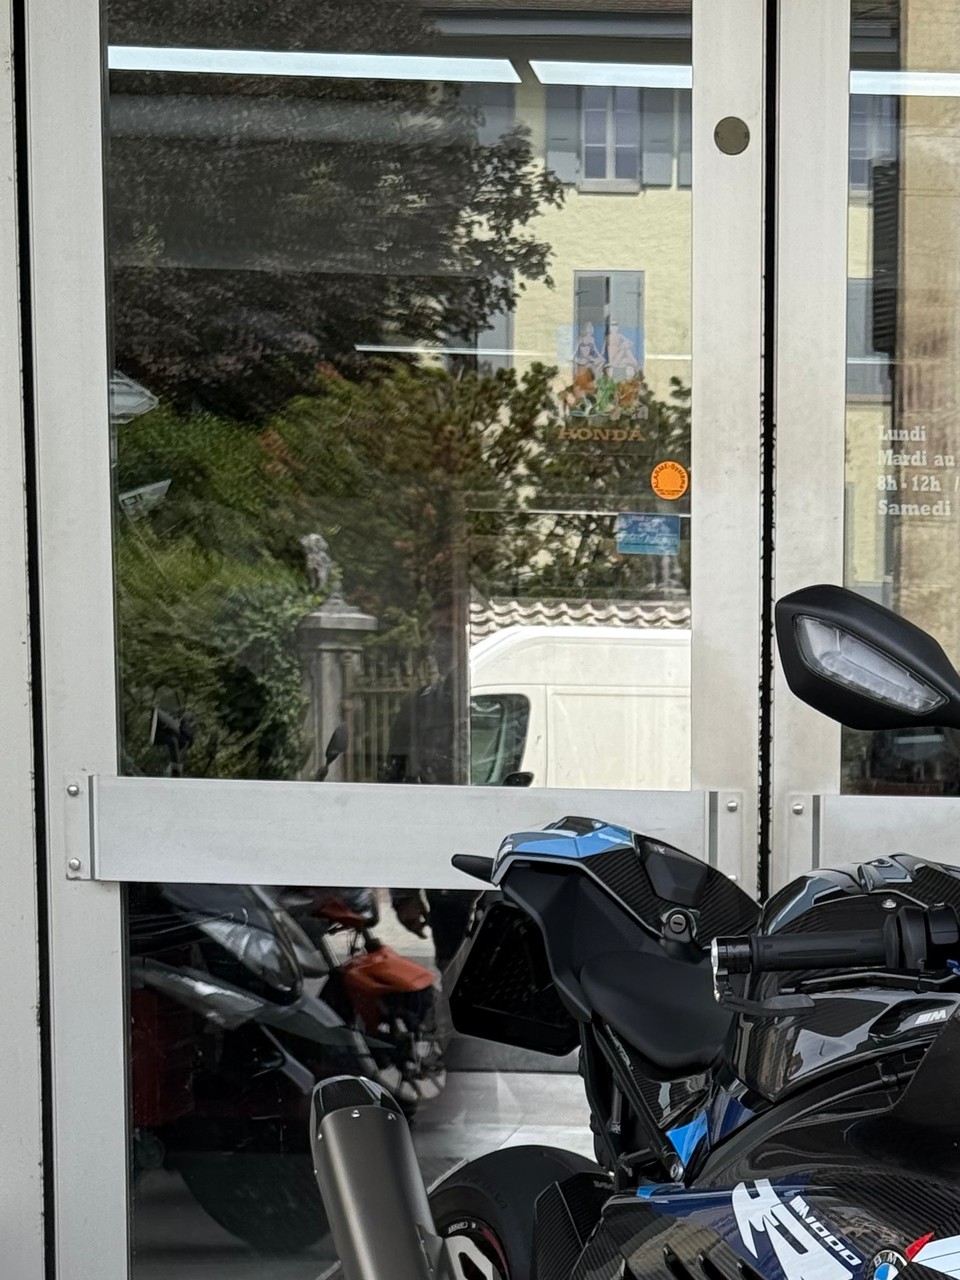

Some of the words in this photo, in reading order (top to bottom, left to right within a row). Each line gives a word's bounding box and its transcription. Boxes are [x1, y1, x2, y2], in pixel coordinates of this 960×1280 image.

[558, 428, 646, 442] HONDA
[878, 425, 926, 441] Lundi
[878, 449, 928, 466] Mardi
[934, 454, 956, 467] au
[877, 474, 898, 491] 8h
[912, 474, 942, 492] 12h
[954, 476, 960, 492] /
[878, 499, 951, 516] Samedi
